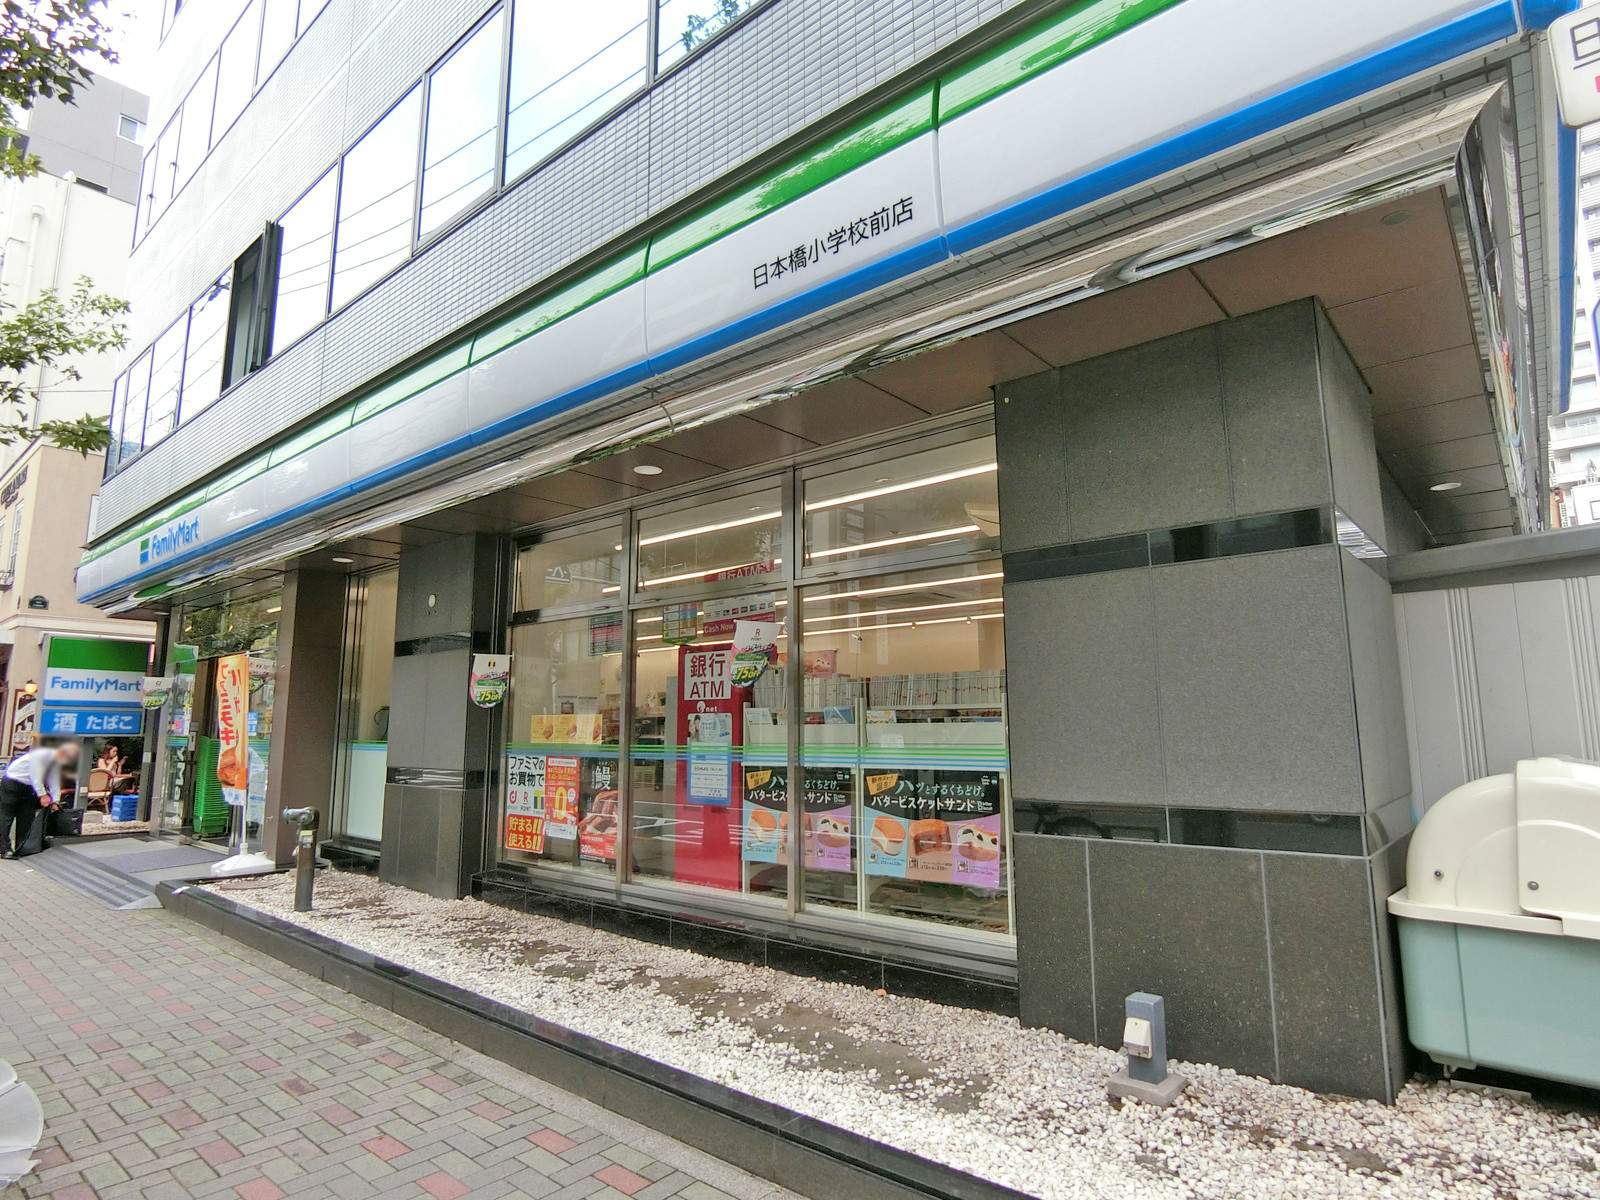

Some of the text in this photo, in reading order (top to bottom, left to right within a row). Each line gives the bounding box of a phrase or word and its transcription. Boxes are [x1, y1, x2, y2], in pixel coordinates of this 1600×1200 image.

[753, 196, 913, 289] 日本橋小学校前店
[152, 515, 199, 560] FamilyMart
[690, 653, 725, 678] 銀行
[51, 676, 142, 693] FamilyMart
[689, 680, 724, 699] ATM
[53, 712, 78, 732] 酒
[86, 715, 133, 730] たばこ
[509, 756, 545, 771] ファミマの
[509, 771, 545, 787] お買物で
[894, 780, 985, 797] ハッとするくちどけ。
[871, 795, 976, 812] バタービスケットサンド
[508, 831, 542, 851] 使える!!
